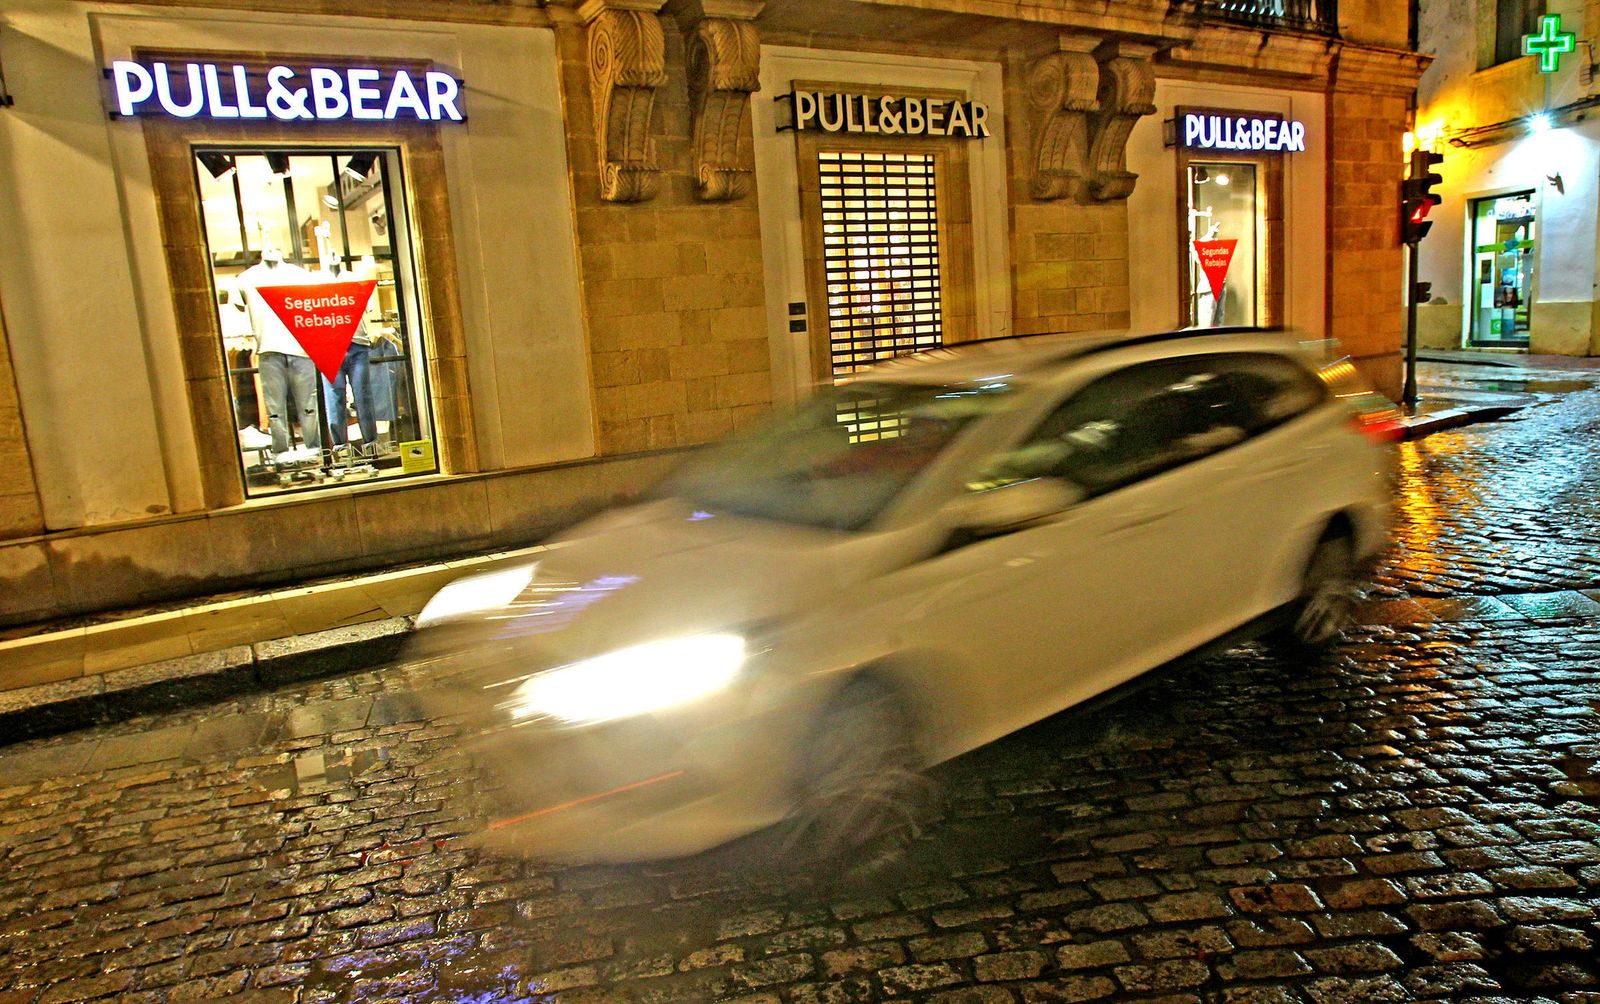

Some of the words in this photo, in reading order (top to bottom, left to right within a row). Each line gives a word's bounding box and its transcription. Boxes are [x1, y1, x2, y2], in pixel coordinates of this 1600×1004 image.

[113, 60, 463, 121] PULL&BEAR
[794, 90, 990, 137] PULL&BEAR
[1185, 113, 1306, 152] PULL&BEAR
[1202, 247, 1228, 257] Segundas
[1205, 259, 1226, 267] Rebajas
[284, 294, 355, 311] Segundas
[294, 313, 352, 328] Rebajas
